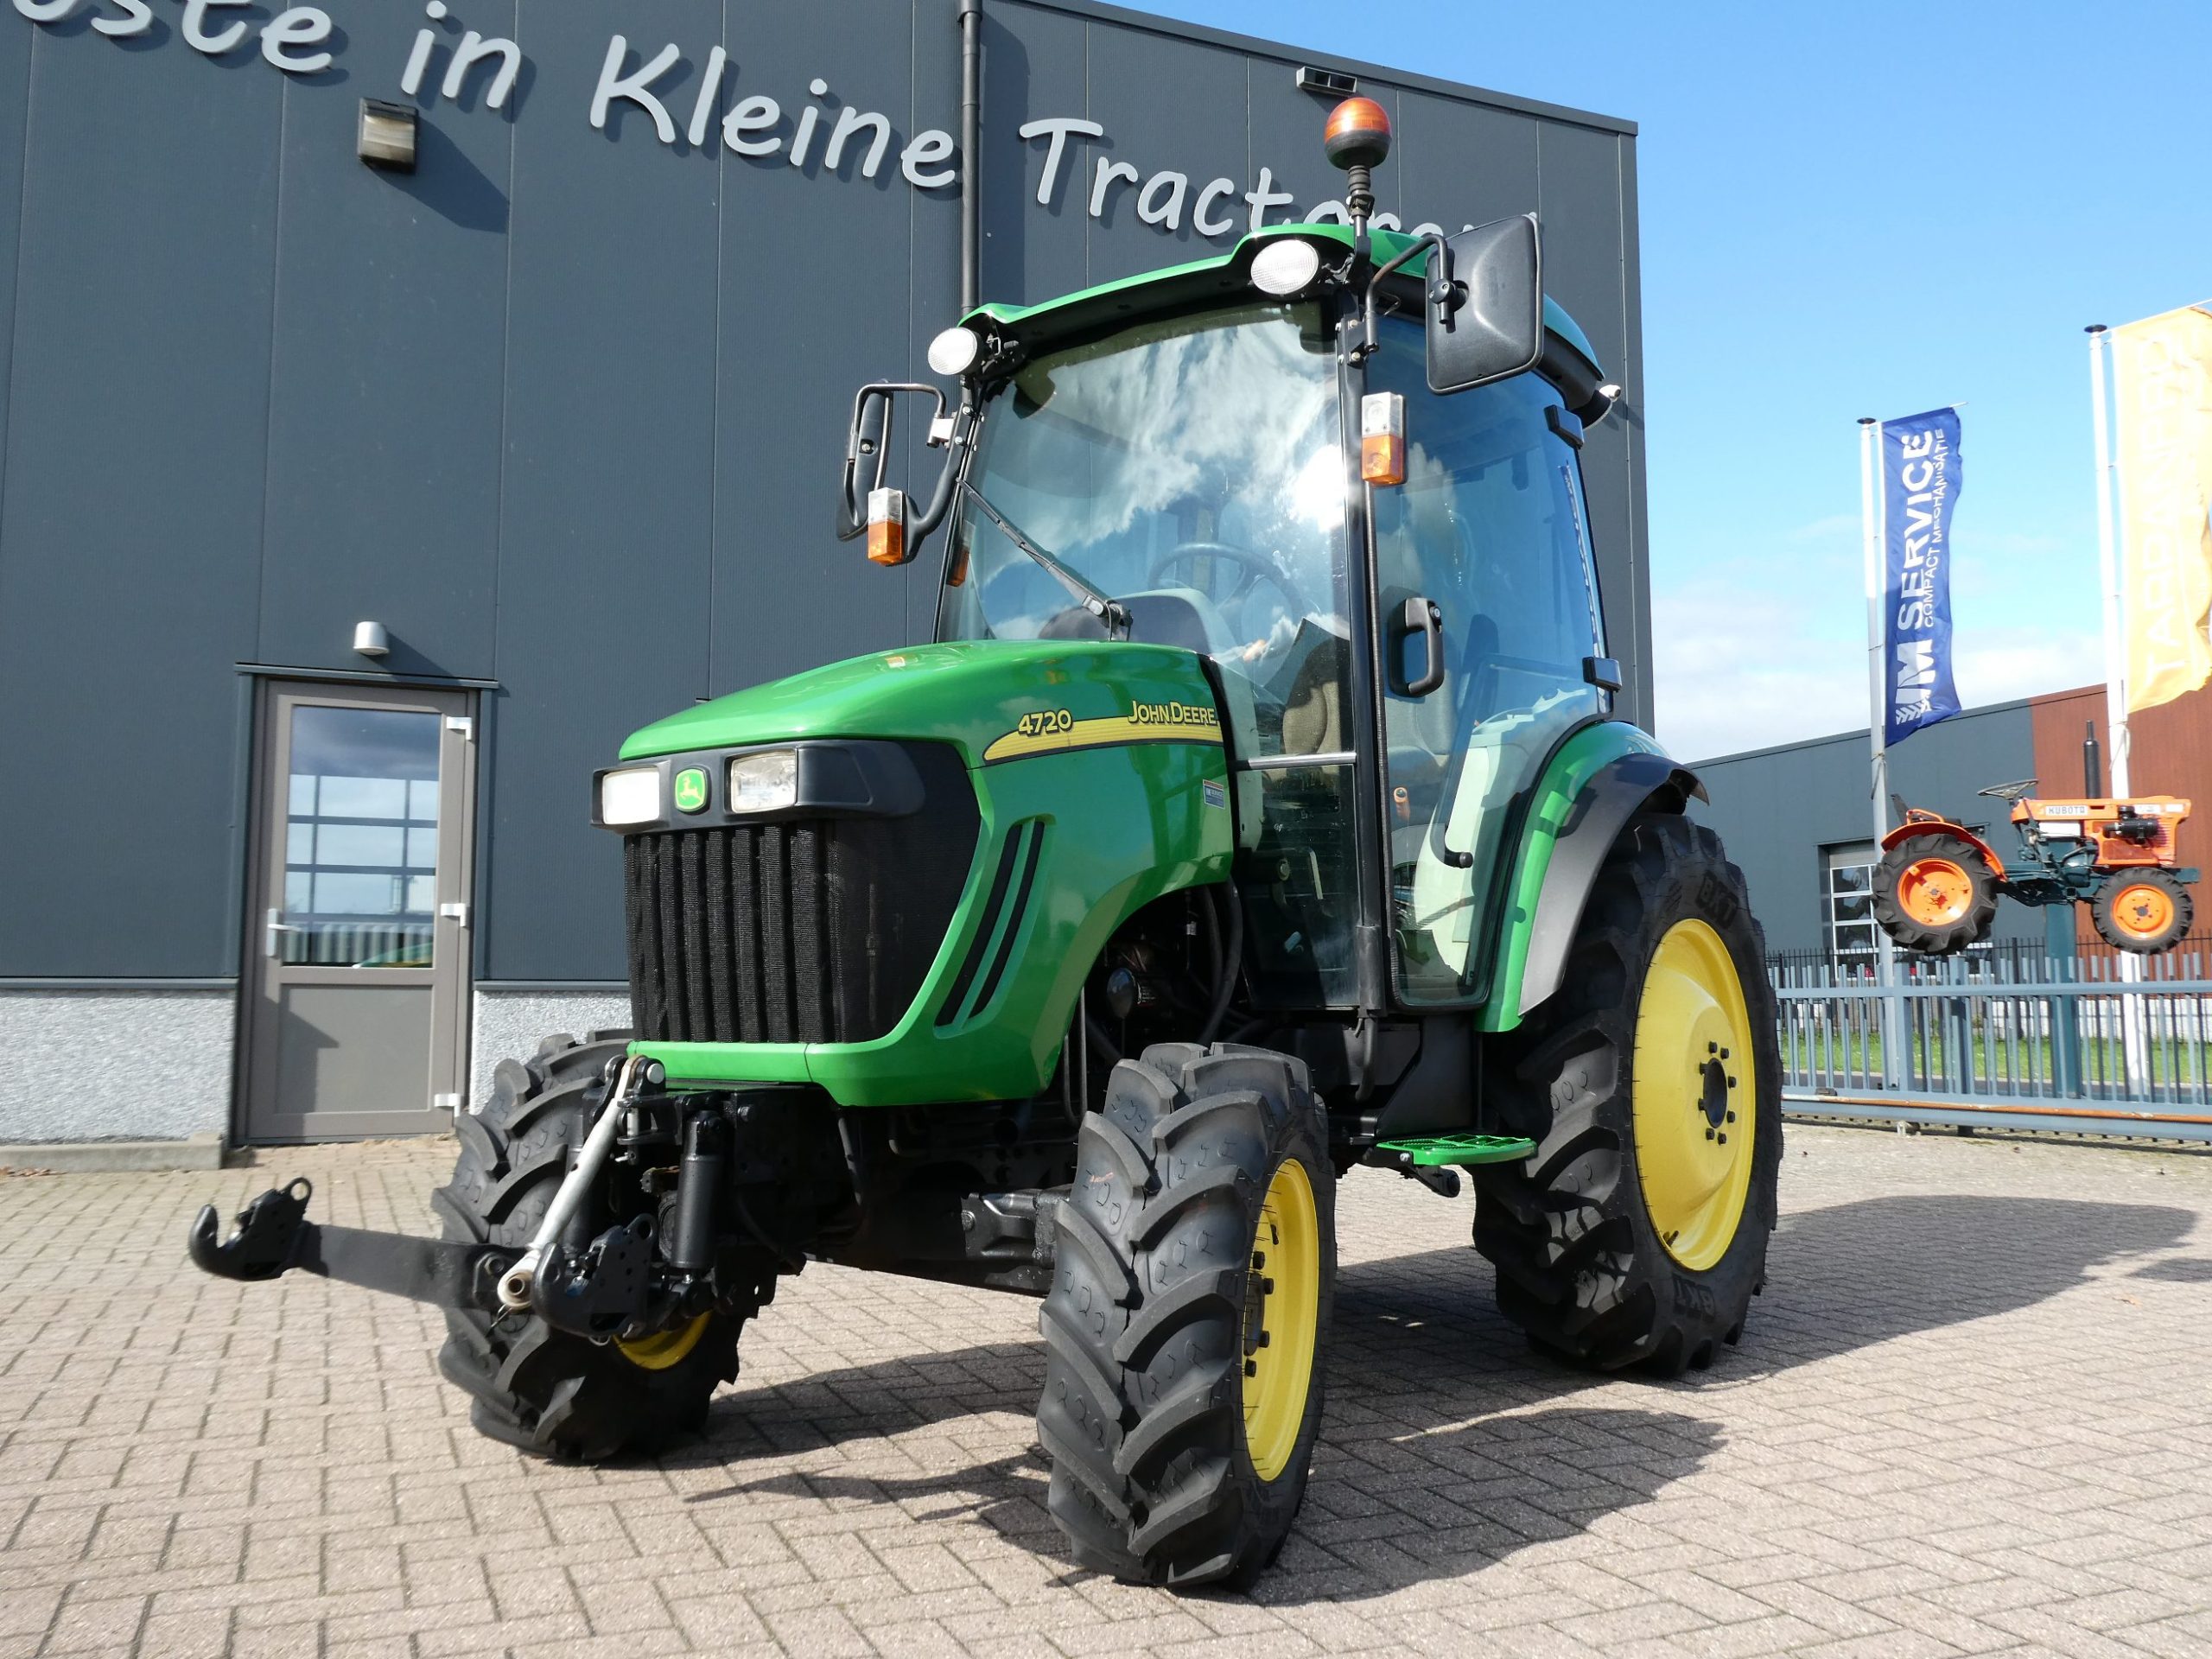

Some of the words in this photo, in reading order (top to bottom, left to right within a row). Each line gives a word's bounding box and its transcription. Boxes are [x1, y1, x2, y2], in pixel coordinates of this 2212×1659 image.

[401, 2, 521, 109] in
[589, 34, 957, 188] Kleine
[1897, 429, 1935, 632] SERVICE
[1923, 546, 1941, 628] COMPACT
[1018, 709, 1074, 735] 4720
[1128, 700, 1170, 724] JOHN
[1169, 702, 1217, 725] DEERE
[2048, 805, 2086, 815] KUBOTA
